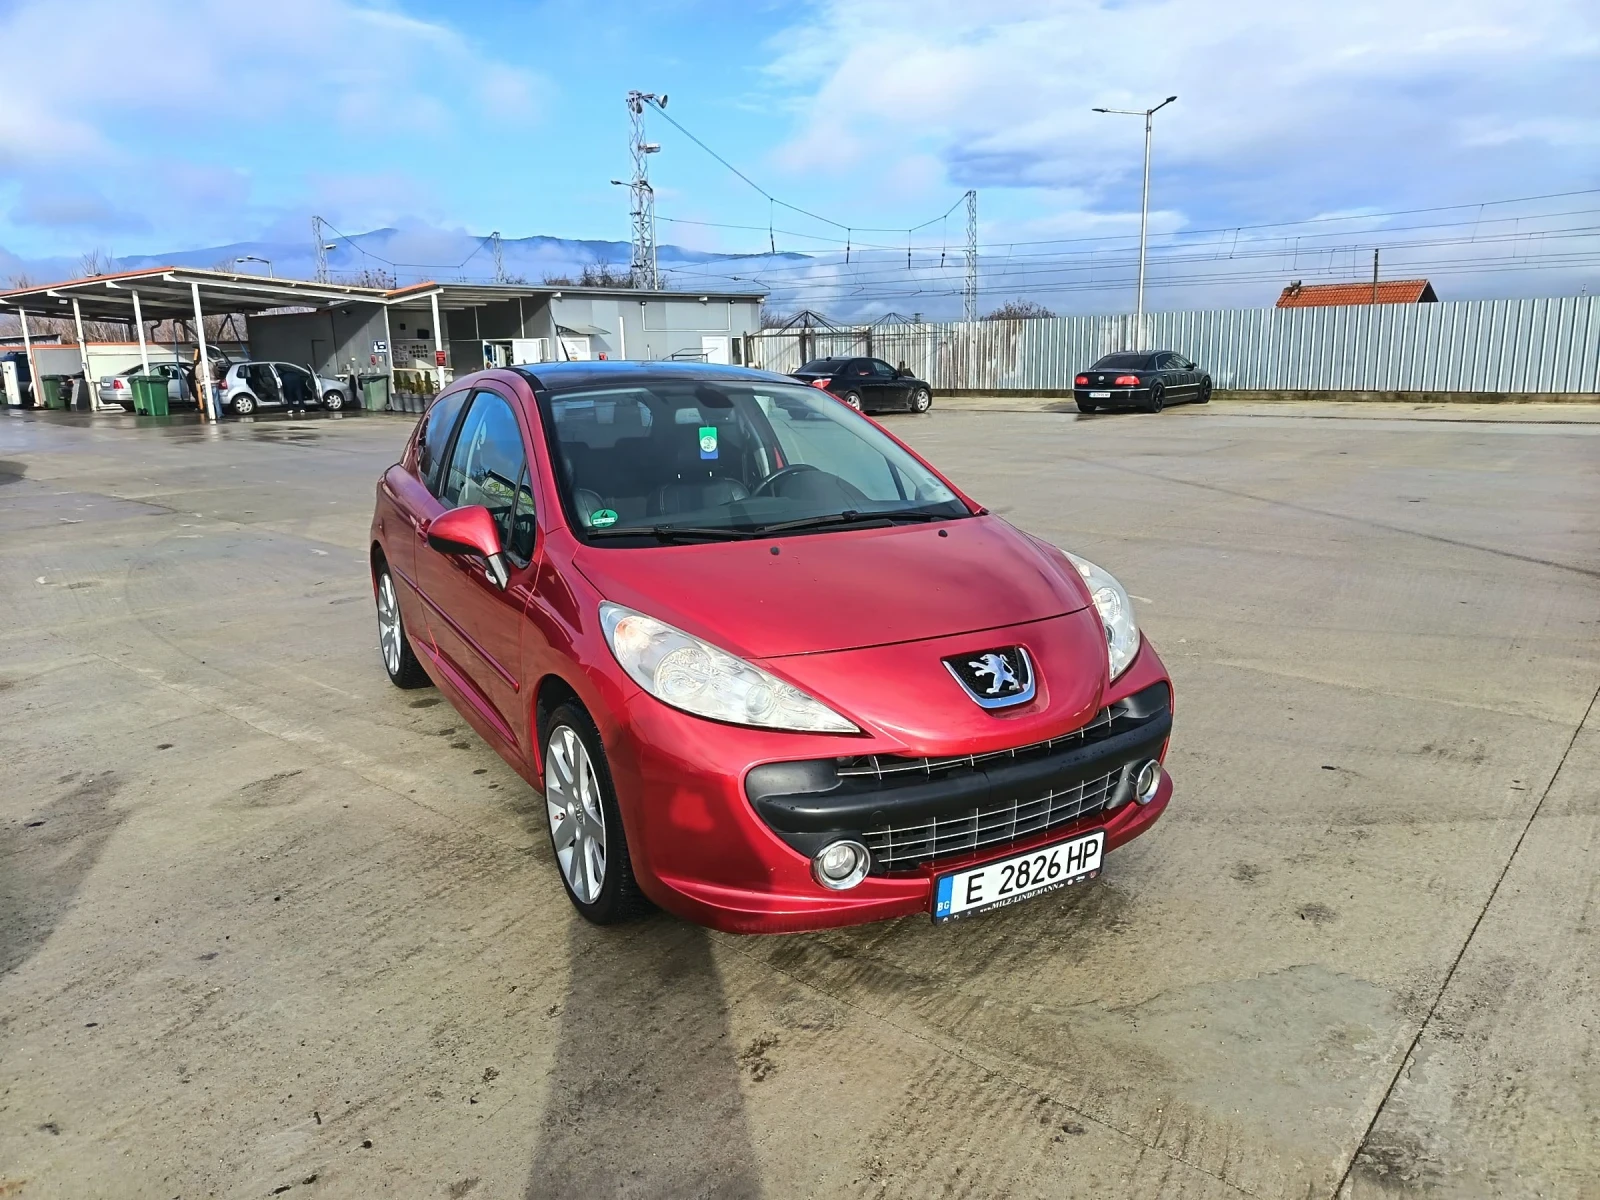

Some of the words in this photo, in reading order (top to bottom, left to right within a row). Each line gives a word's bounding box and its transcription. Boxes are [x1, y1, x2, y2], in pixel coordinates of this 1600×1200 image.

[966, 872, 985, 905] E
[998, 850, 1061, 895] 2826
[1066, 838, 1099, 874] HP
[937, 901, 950, 911] BG
